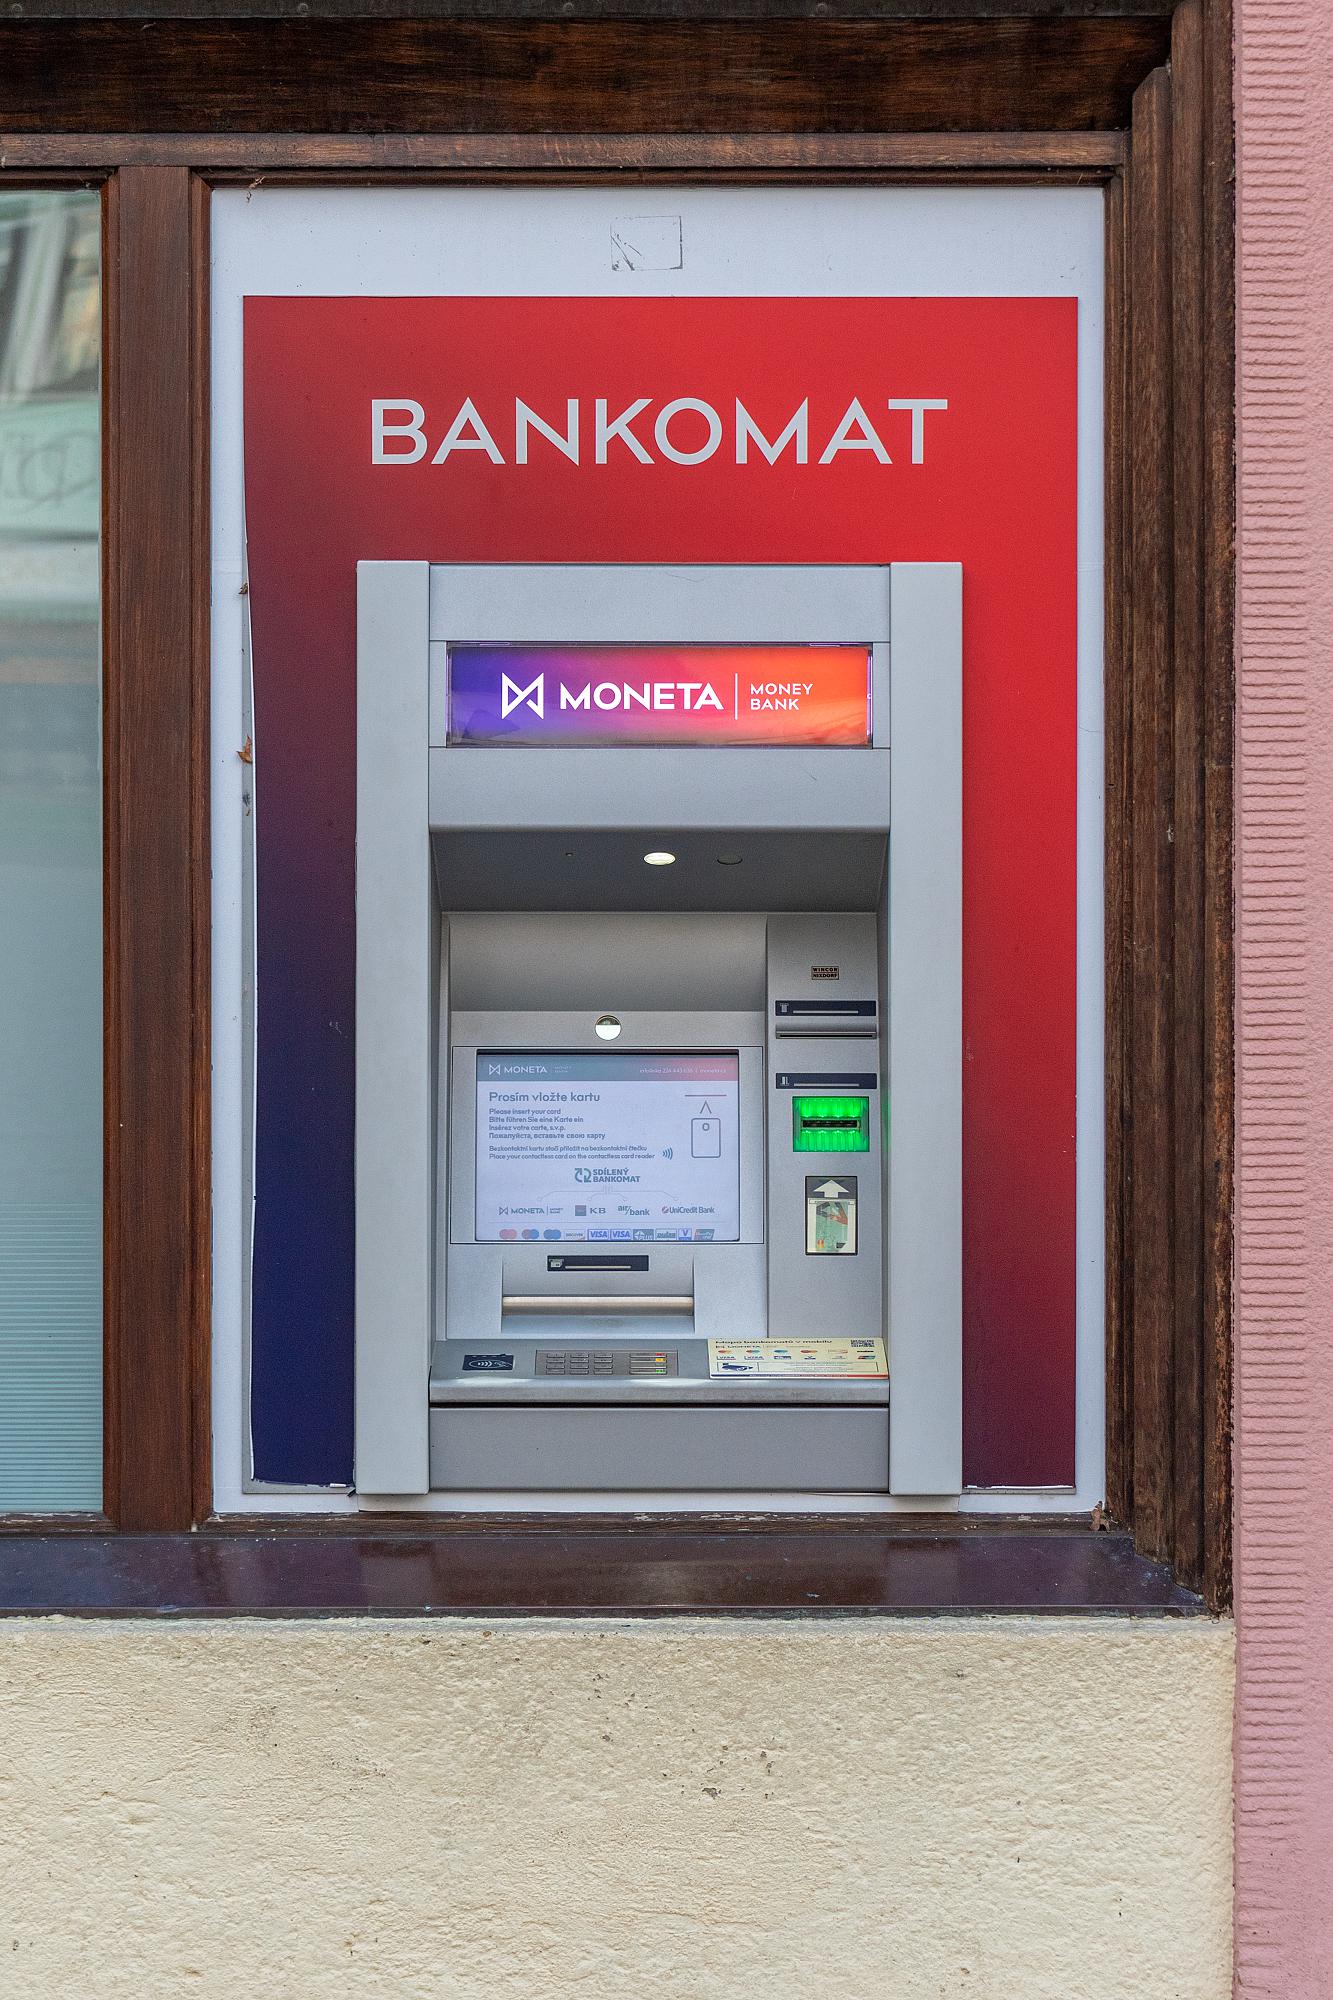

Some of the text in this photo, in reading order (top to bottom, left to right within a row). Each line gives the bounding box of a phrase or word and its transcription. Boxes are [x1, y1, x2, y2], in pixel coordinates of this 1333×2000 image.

[371, 397, 948, 466] BANKOMAT
[750, 683, 813, 695] MONEY
[560, 682, 724, 711] MONETA
[750, 699, 799, 710] BANK
[504, 1065, 548, 1074] MONETA
[489, 1092, 600, 1102] Prosím vložte kartu
